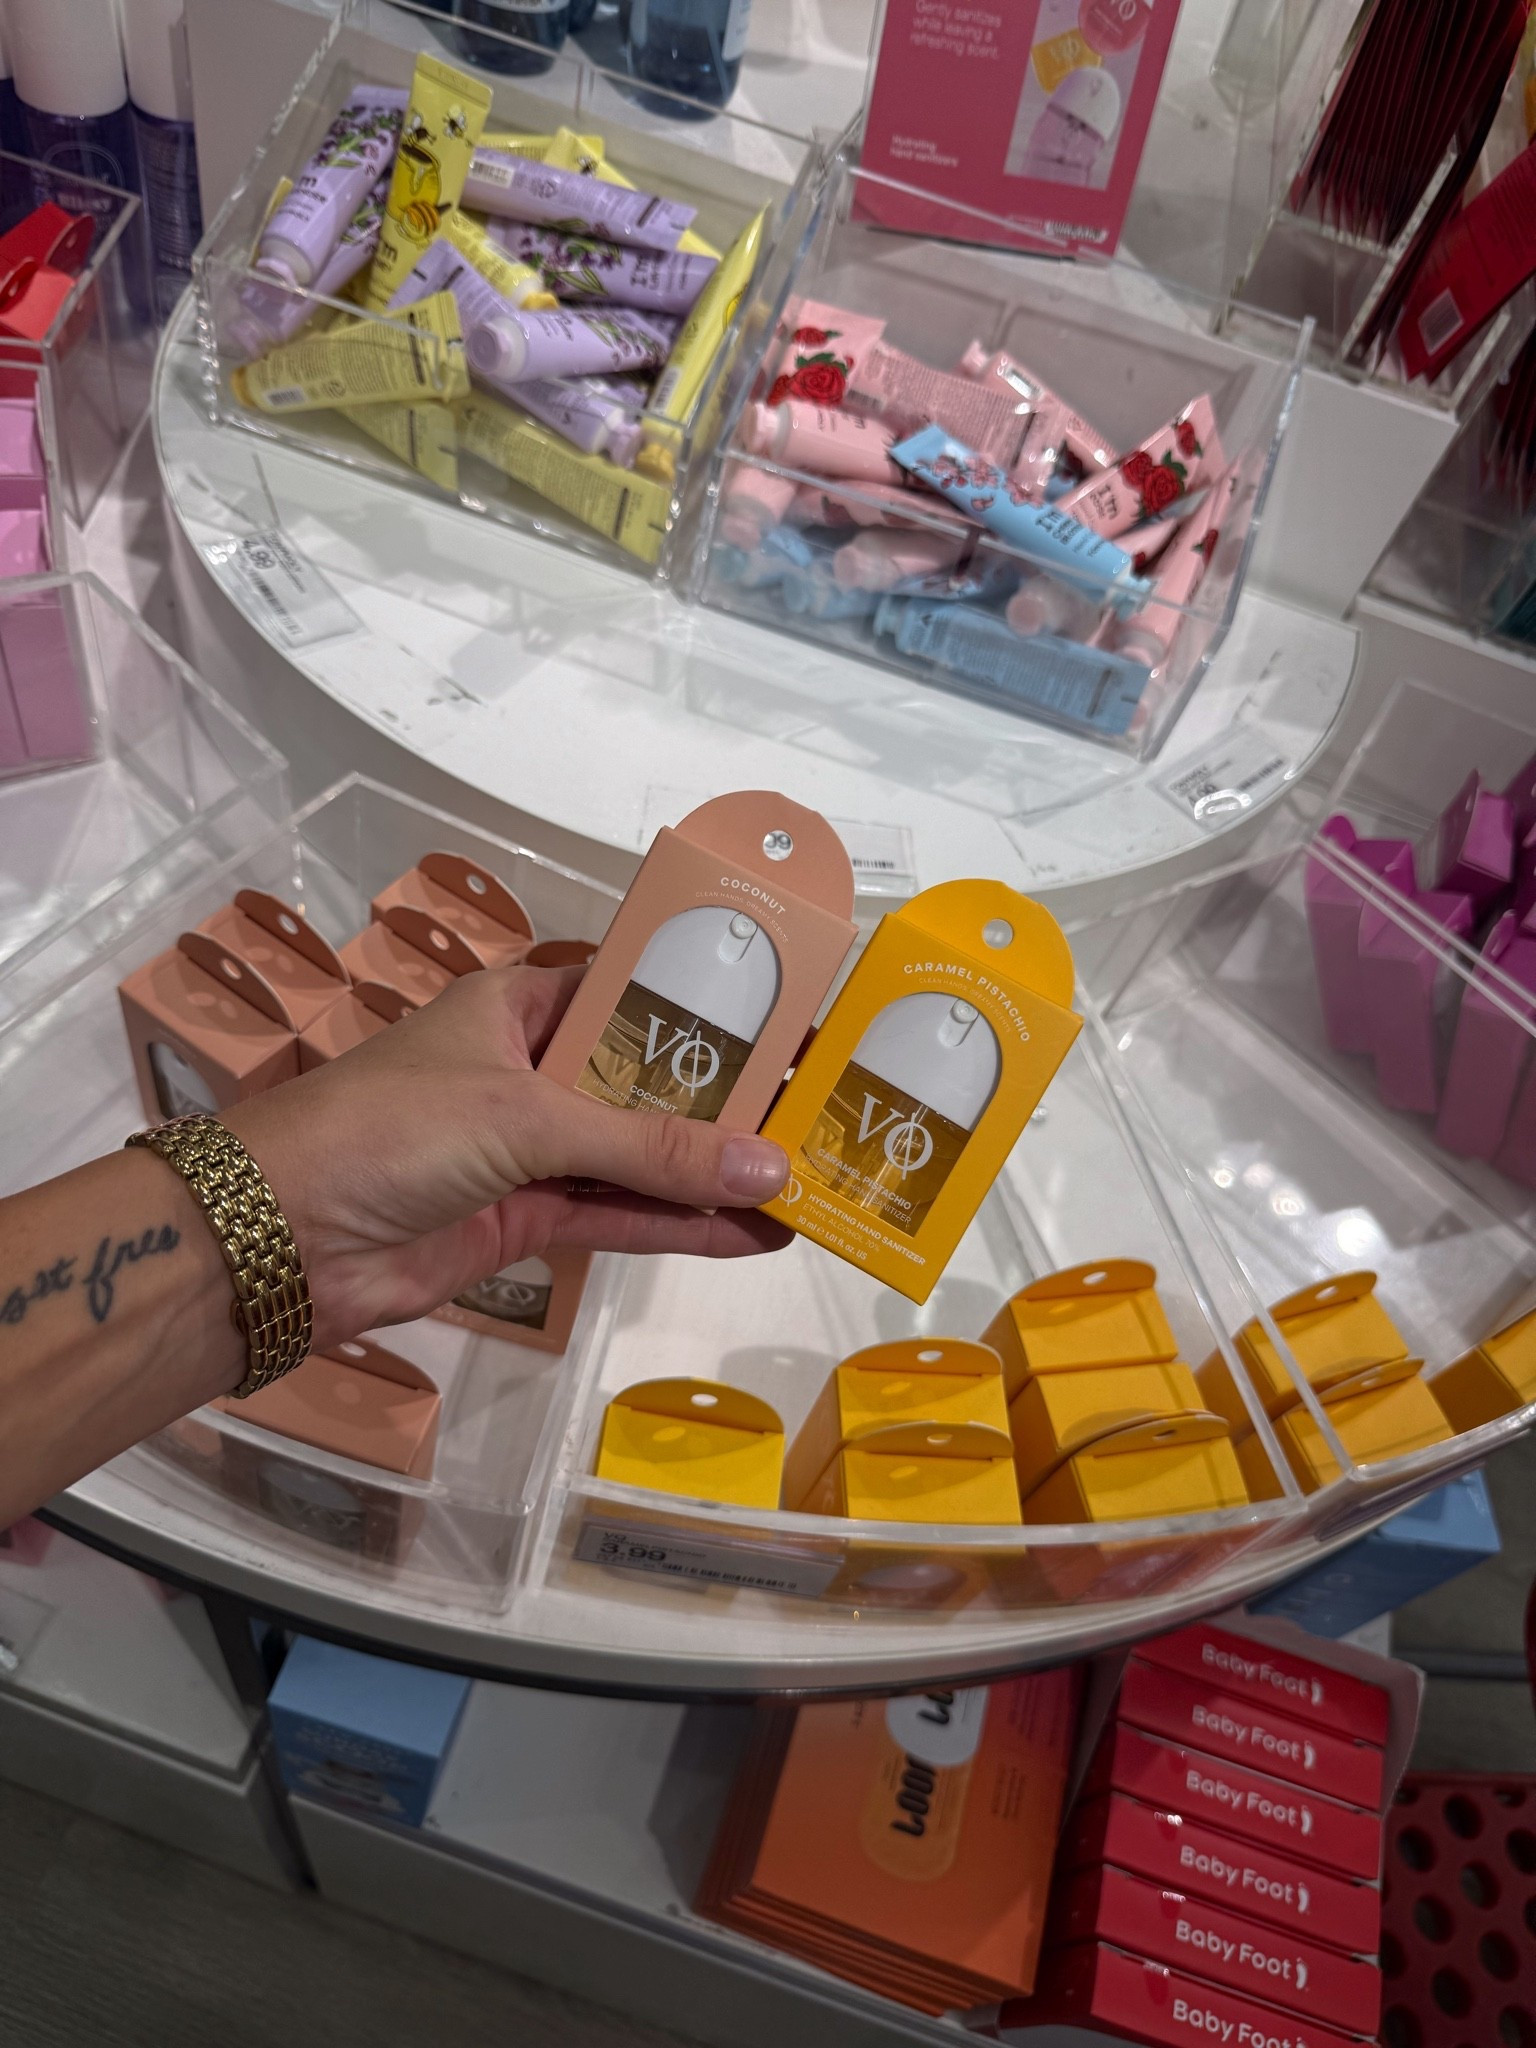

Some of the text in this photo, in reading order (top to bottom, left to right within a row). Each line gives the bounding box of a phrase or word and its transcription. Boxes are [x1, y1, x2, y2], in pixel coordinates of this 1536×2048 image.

[720, 876, 786, 915] COCONUT
[903, 962, 1031, 1042] CARAMEL PISTACHIO
[919, 977, 943, 985] CLEAN
[592, 1078, 638, 1108] HYDRATING
[629, 1085, 678, 1114] COCONUT
[806, 1154, 912, 1225] HYDRATING HAND SANITIZER
[817, 1148, 912, 1211] CARAMEL PISTACHIO
[796, 1214, 807, 1226] 30
[806, 1220, 818, 1232] ml
[824, 1230, 838, 1243] 1.01
[855, 1249, 869, 1261] US
[802, 1203, 881, 1253] ETHYL ALCOHOL 70%
[807, 1193, 926, 1266] HYDRATING HAND SANITIZER
[599, 1541, 667, 1562] 3.99
[1202, 1642, 1309, 1698] Baby Foot
[1192, 1704, 1301, 1762] Baby Foot
[1186, 1769, 1298, 1828] Baby Foot
[1180, 1844, 1294, 1906] Baby Foot
[1175, 1918, 1292, 1981] Baby Foot
[1172, 1998, 1235, 2043] Baby
